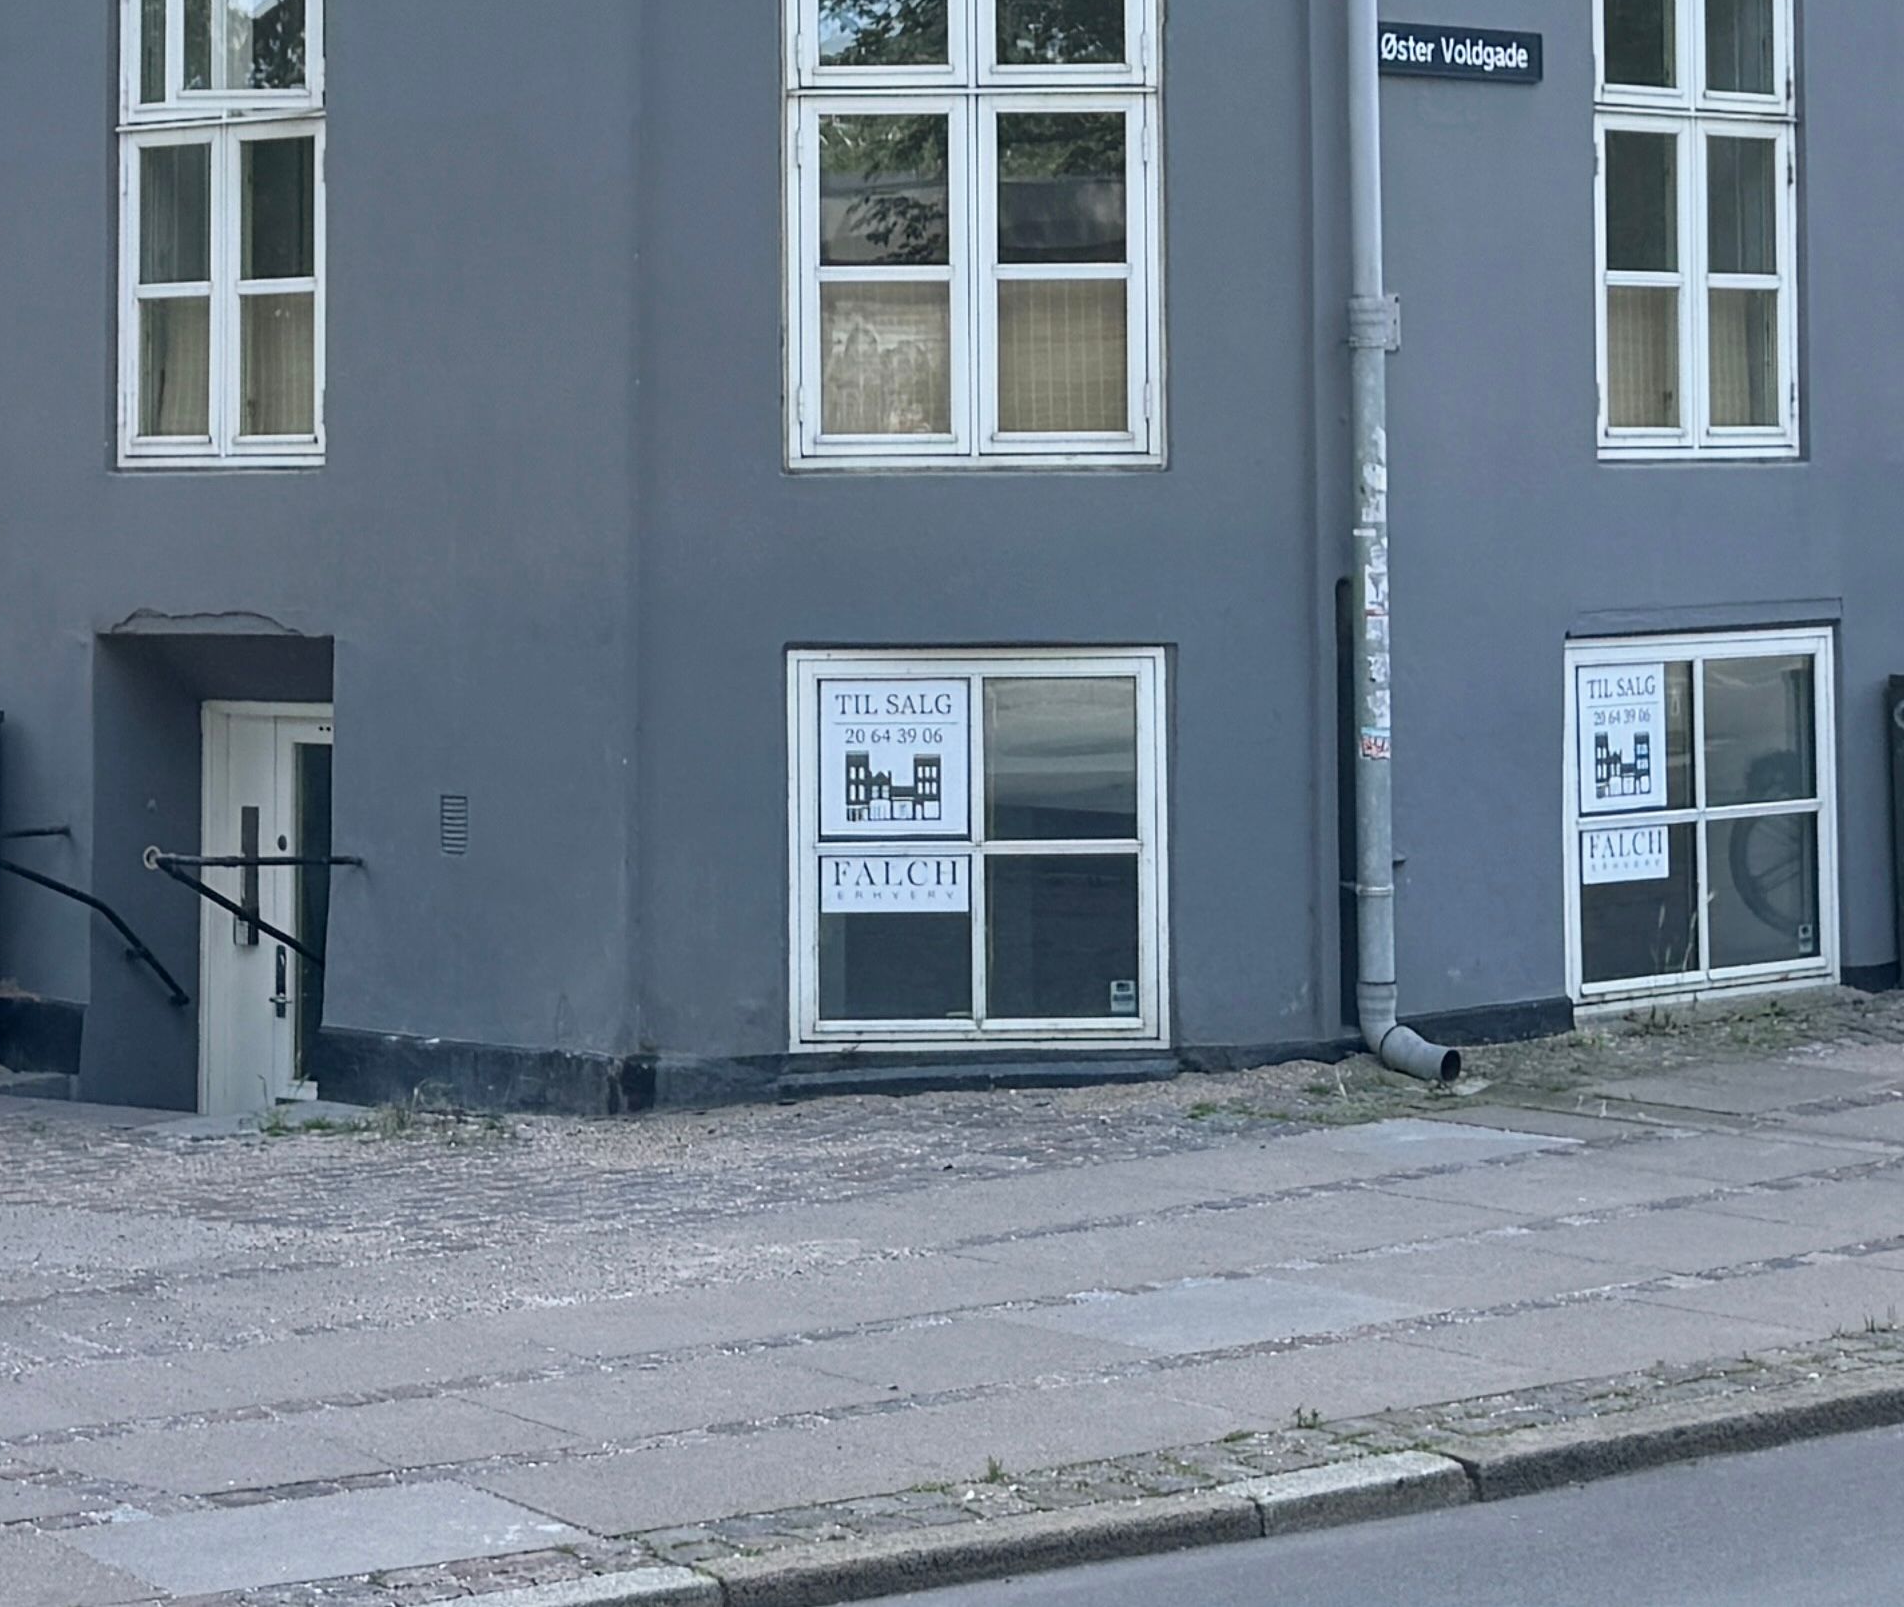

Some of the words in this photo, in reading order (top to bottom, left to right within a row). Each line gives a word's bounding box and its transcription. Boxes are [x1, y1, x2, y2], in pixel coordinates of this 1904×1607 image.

[1380, 32, 1436, 63] Øster
[1441, 36, 1529, 72] Voldgade
[1586, 678, 1613, 699] TIL
[1617, 675, 1656, 698] SALG
[834, 693, 878, 715] TIL
[885, 693, 953, 715] SALG
[845, 728, 865, 744] 20
[871, 728, 890, 744] 64
[897, 728, 917, 744] 39
[922, 728, 943, 744] 06
[1589, 830, 1662, 858] FALCH
[834, 860, 958, 886] FALCH
